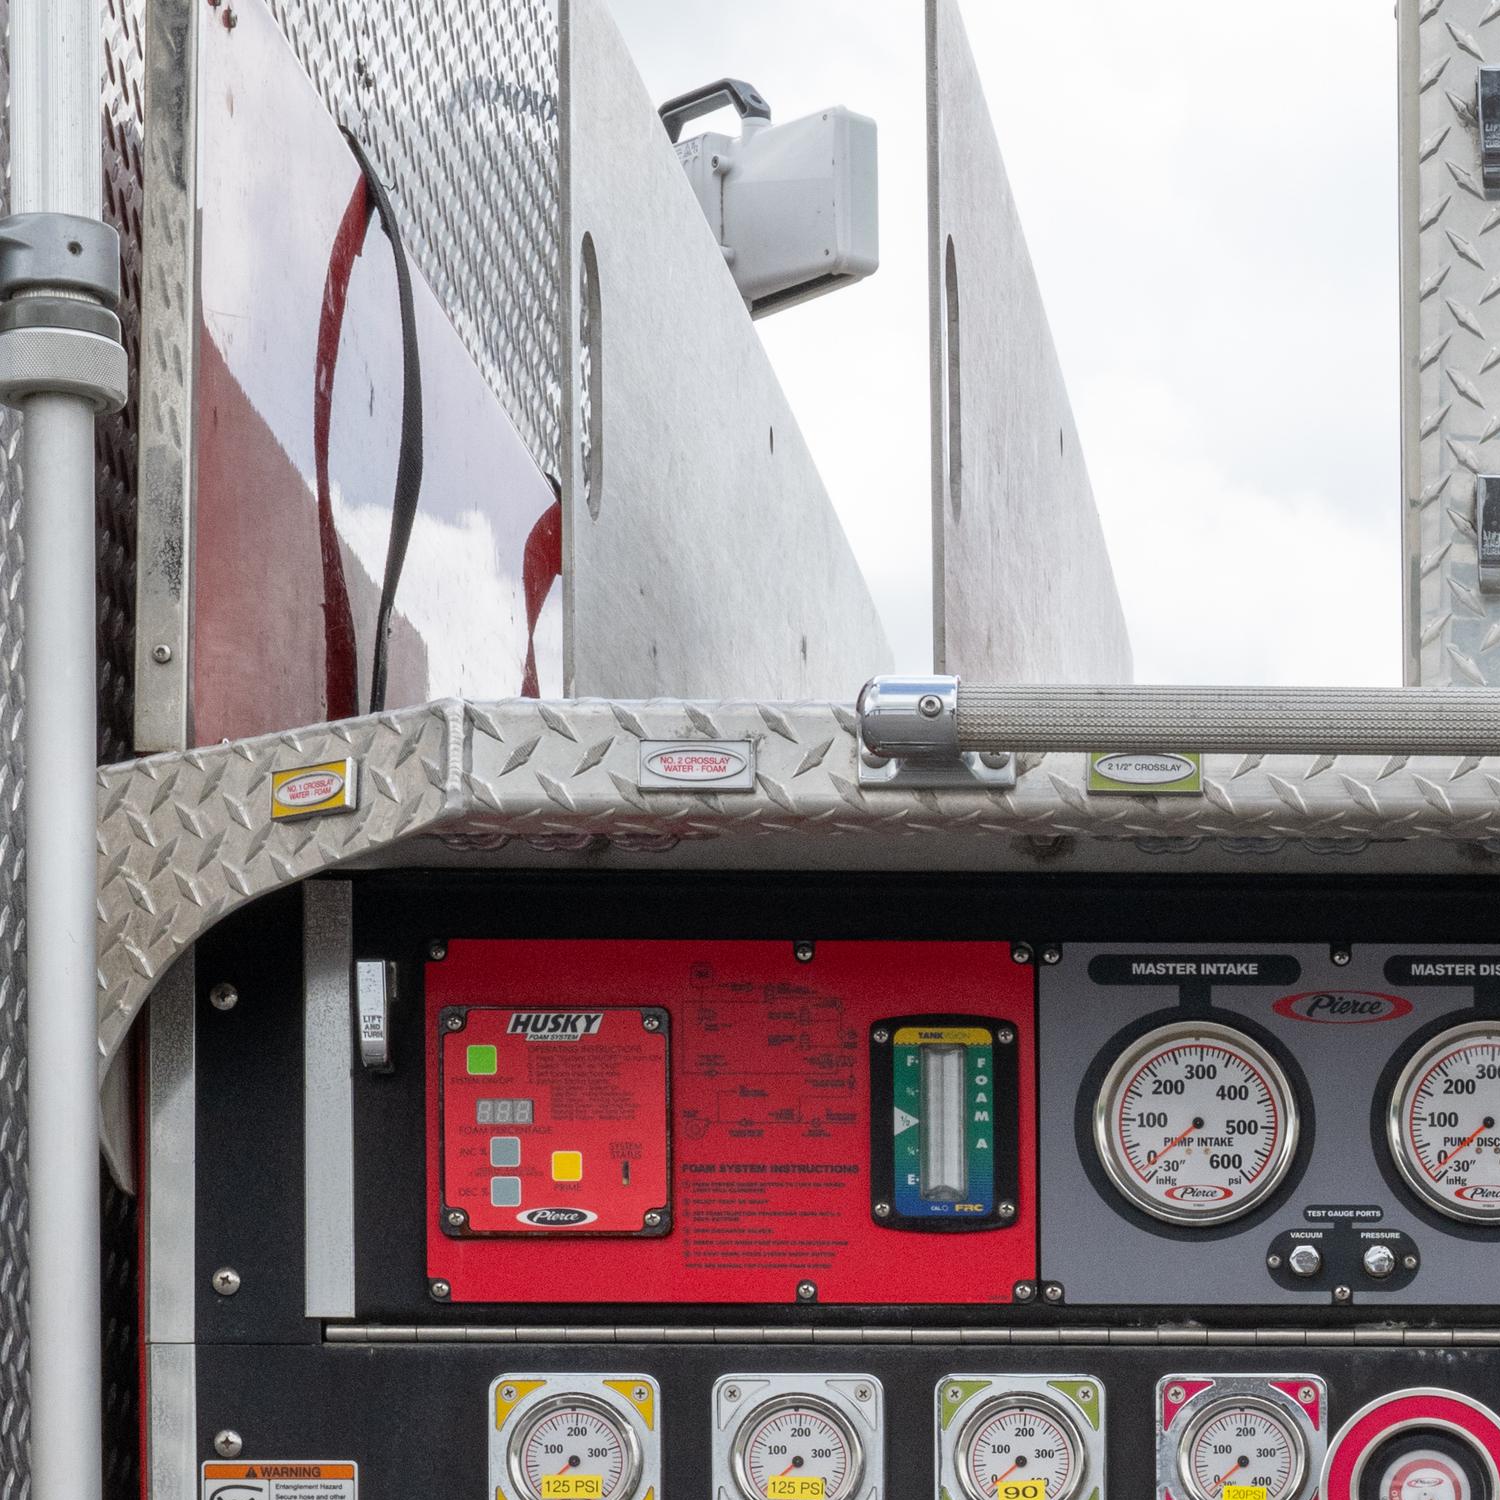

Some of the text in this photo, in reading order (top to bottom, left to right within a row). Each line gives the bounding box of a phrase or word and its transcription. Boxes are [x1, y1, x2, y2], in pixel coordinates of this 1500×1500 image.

[1132, 962, 1258, 977] MASTER INTAKE
[1411, 962, 1476, 978] MASTER
[1306, 994, 1384, 1019] Pierce
[511, 1014, 600, 1033] HUSKY
[1184, 1064, 1217, 1080] 300
[1152, 1080, 1184, 1095] 200
[1216, 1086, 1249, 1101] 400
[1138, 1113, 1168, 1129] 100
[1226, 1120, 1258, 1136] 500
[1443, 1137, 1473, 1148] PUMP
[1209, 1154, 1242, 1171] 600
[1307, 1210, 1381, 1218] TEST GAUGE PORTS
[262, 1467, 321, 1477] WARNING
[545, 1479, 600, 1493] 125 PSI
[1004, 1486, 1038, 1499] 90
[1226, 1489, 1264, 1500] 120PSI
